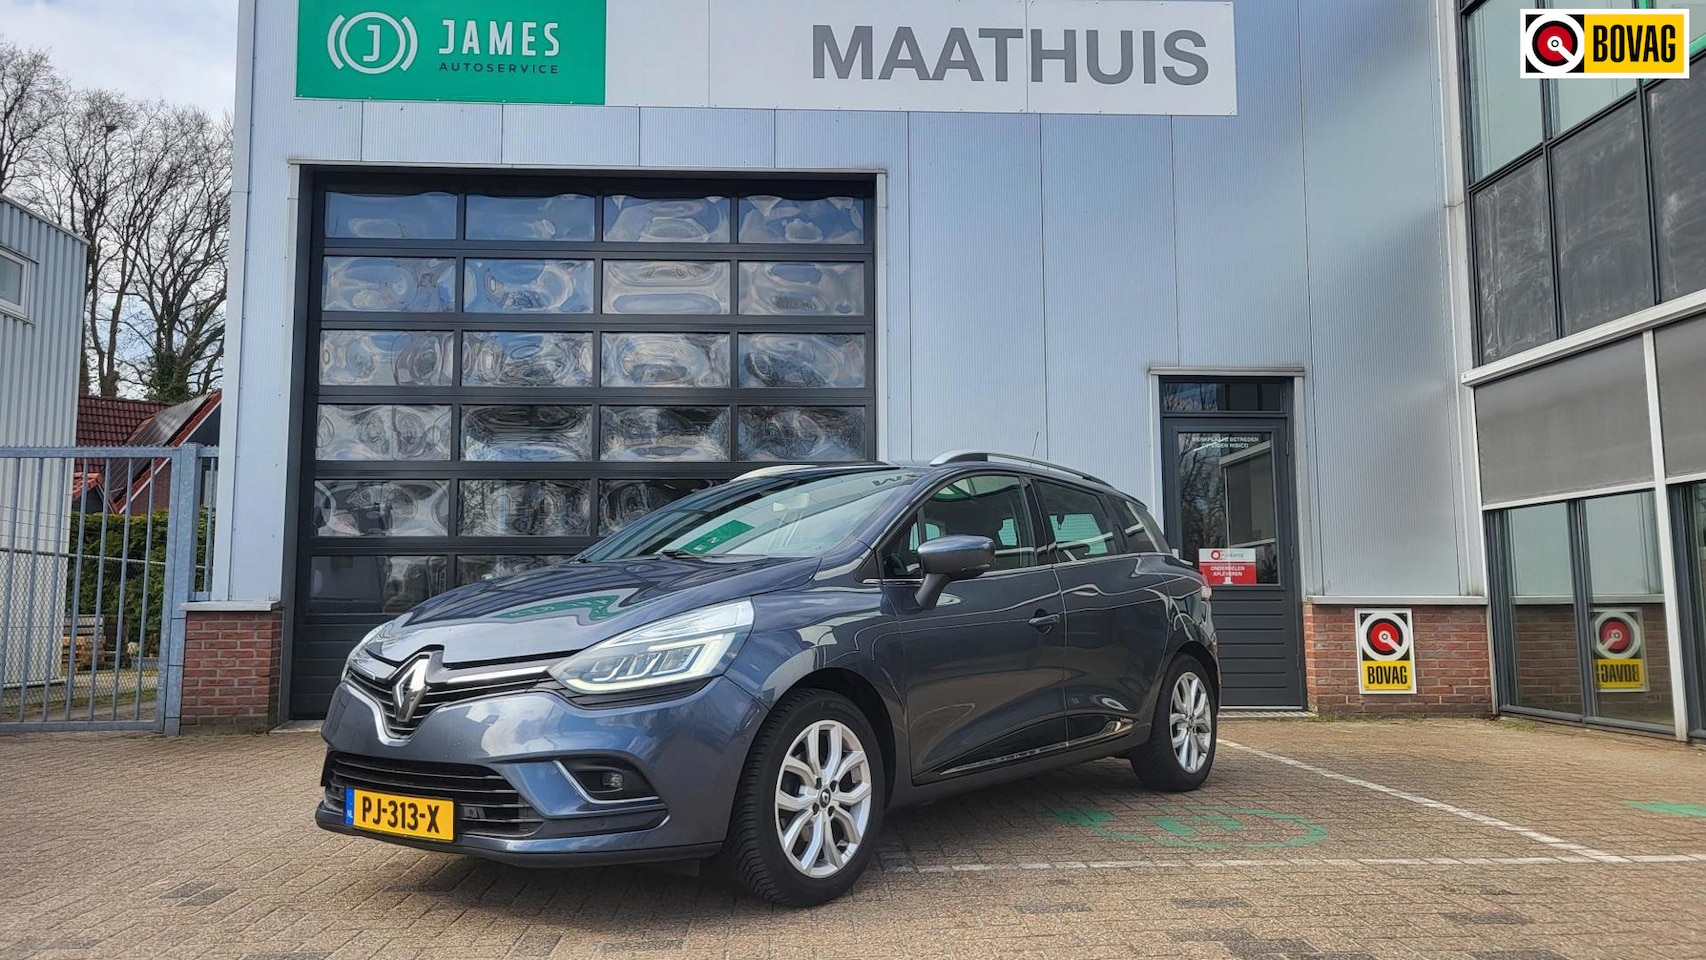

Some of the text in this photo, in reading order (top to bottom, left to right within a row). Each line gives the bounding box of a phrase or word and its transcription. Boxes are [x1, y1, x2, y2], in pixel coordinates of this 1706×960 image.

[438, 19, 560, 57] JAMES
[812, 24, 1210, 86] MAATHUIS
[439, 62, 559, 74] AUTOSERVICE
[1367, 665, 1408, 685] BOVAG
[362, 796, 440, 833] PJ-313-X
